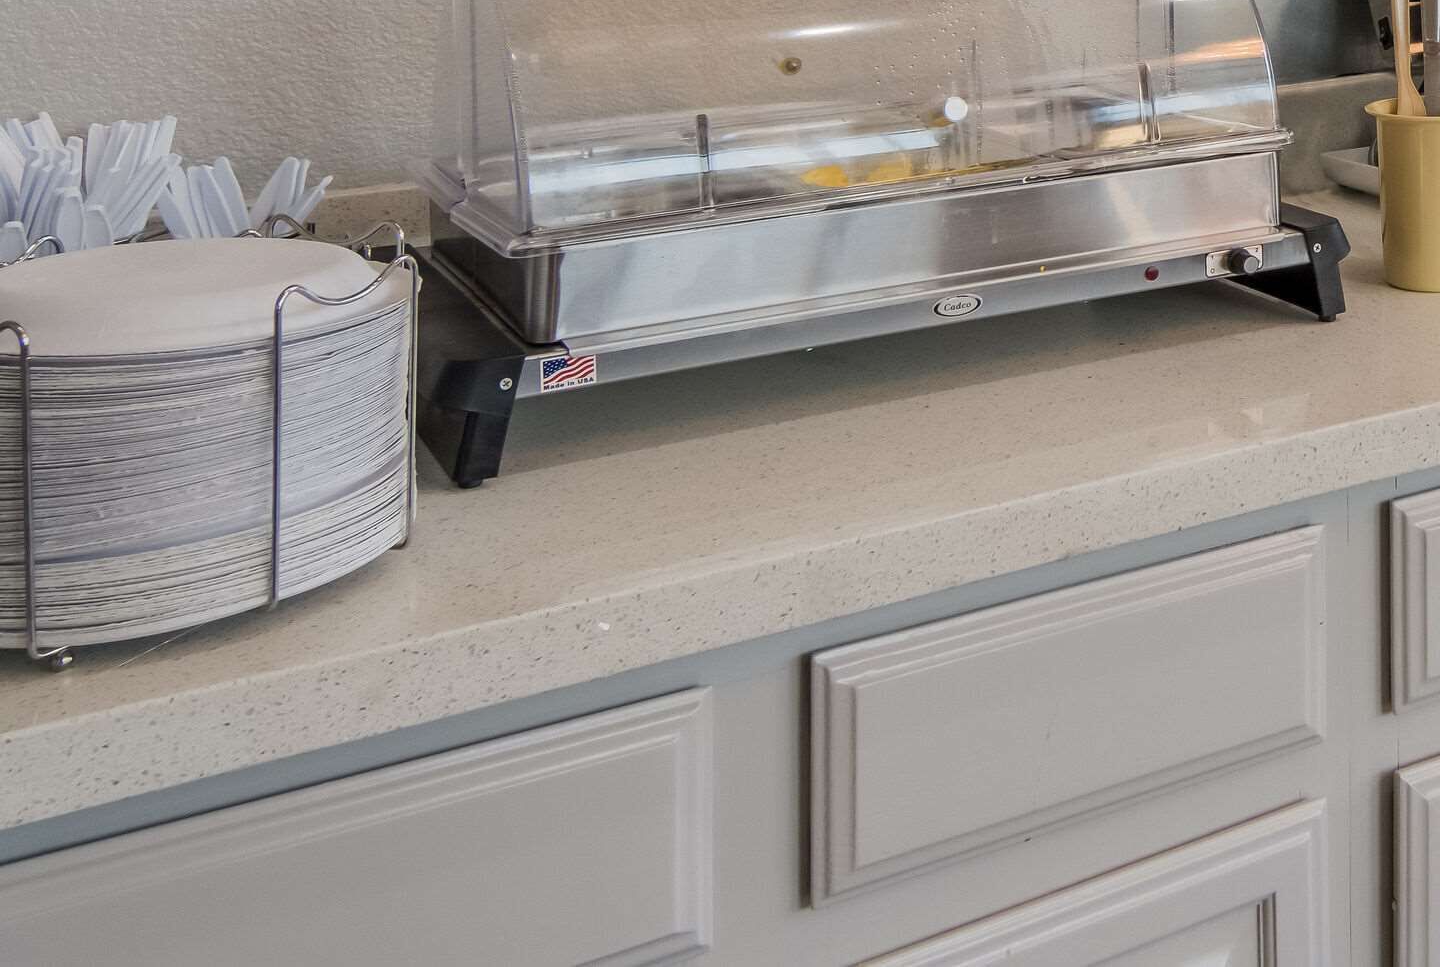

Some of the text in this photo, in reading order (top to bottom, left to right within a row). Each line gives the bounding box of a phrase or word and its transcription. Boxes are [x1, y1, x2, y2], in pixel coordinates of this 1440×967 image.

[943, 301, 972, 312] Cadco
[543, 383, 565, 391] Made
[577, 377, 594, 385] USA
